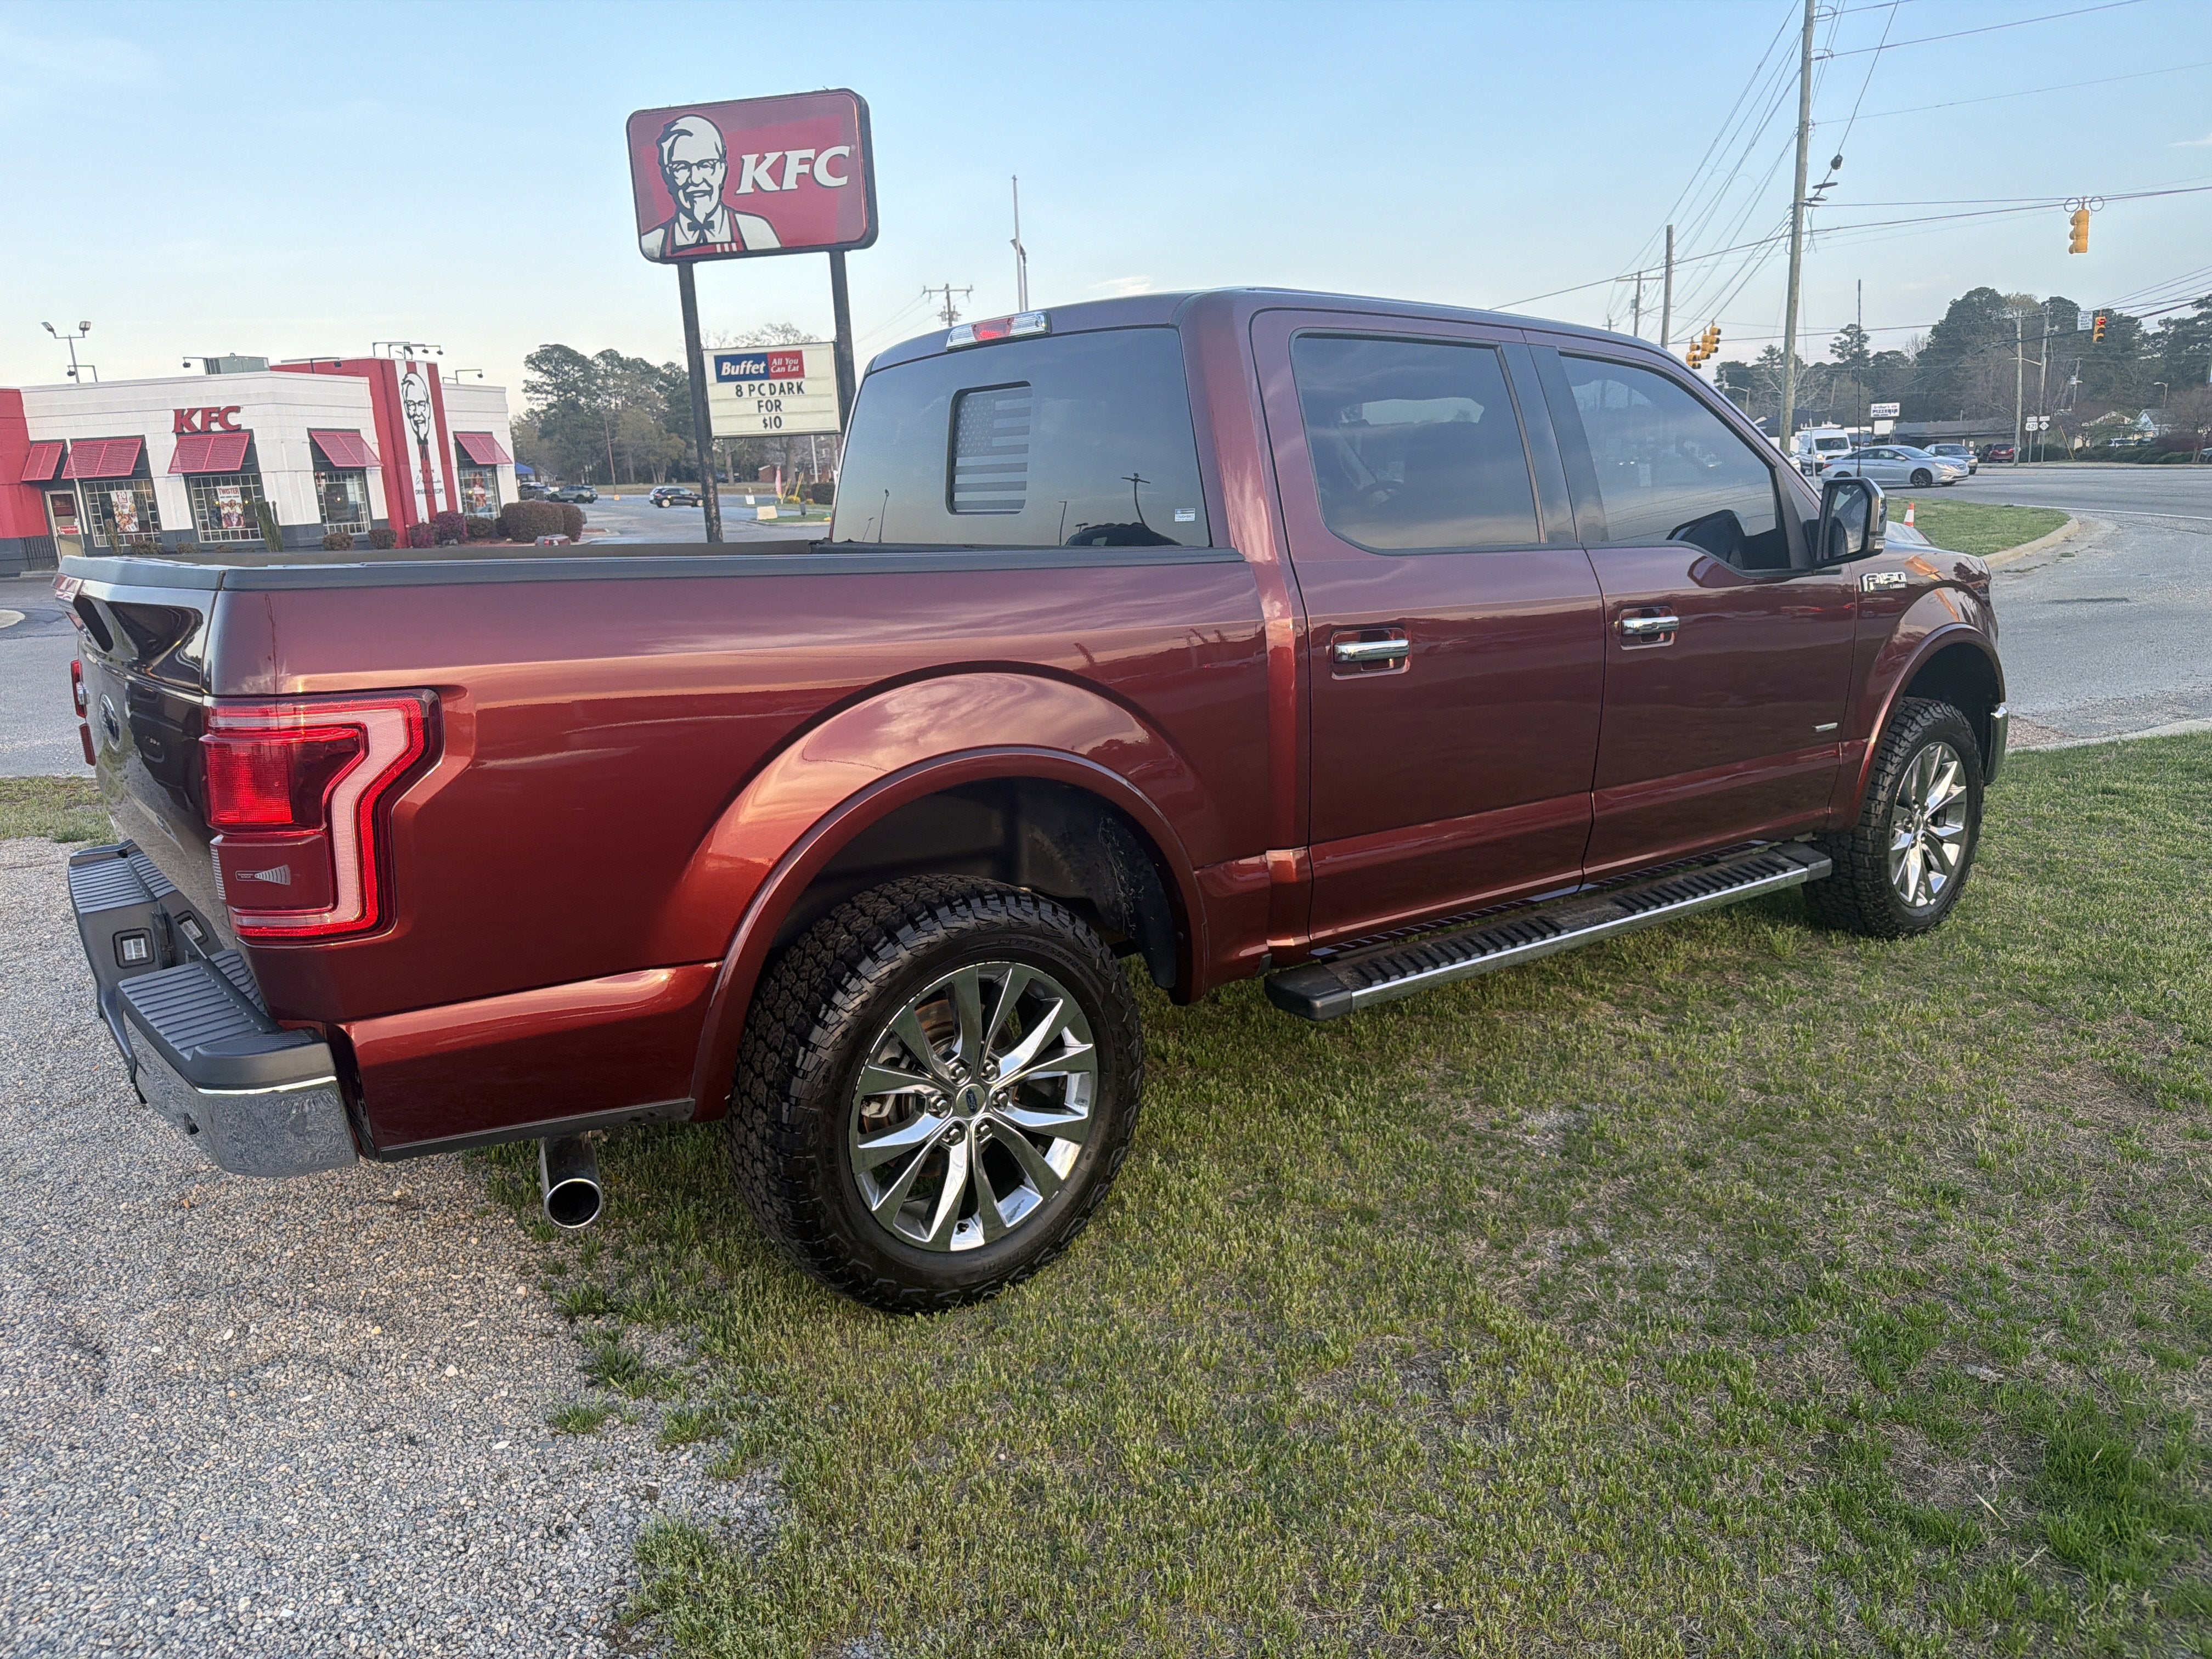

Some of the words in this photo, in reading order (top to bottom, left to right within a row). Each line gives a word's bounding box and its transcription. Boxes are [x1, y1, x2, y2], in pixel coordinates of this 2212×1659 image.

[735, 145, 850, 194] KFC
[721, 360, 766, 376] Buffet
[735, 384, 743, 397] 8
[757, 399, 782, 413] FOR
[172, 405, 241, 433] KFC
[763, 415, 782, 430] $10
